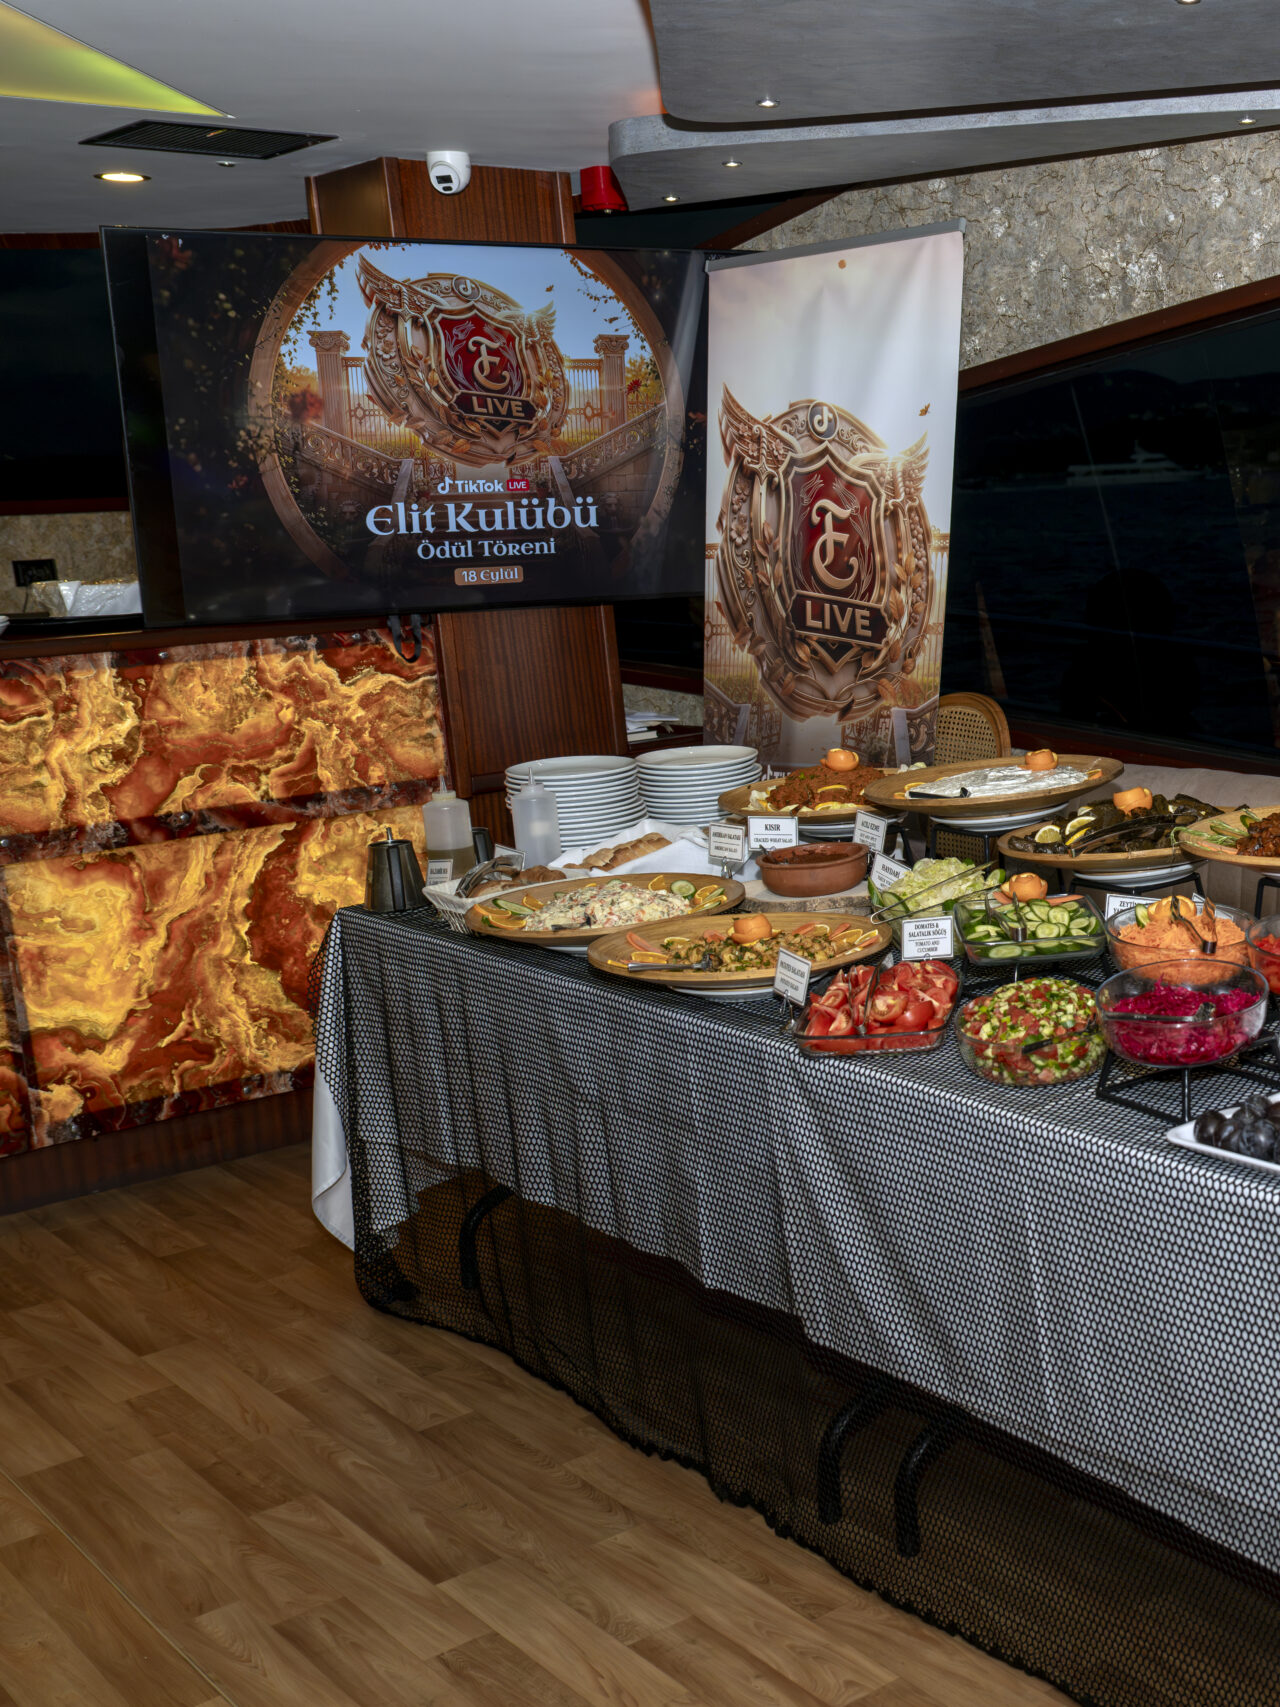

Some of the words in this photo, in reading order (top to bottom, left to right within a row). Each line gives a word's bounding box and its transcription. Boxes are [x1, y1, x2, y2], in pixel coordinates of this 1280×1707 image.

[471, 395, 525, 418] LIVE
[455, 479, 504, 493] TikTok
[508, 481, 527, 489] LIVE
[365, 501, 436, 536] Elit
[444, 495, 600, 533] Kulübü
[416, 540, 474, 560] Ödül
[461, 570, 477, 583] 18
[480, 567, 519, 583] Eylül
[805, 600, 873, 638] LIVE
[764, 823, 781, 831] KISIR
